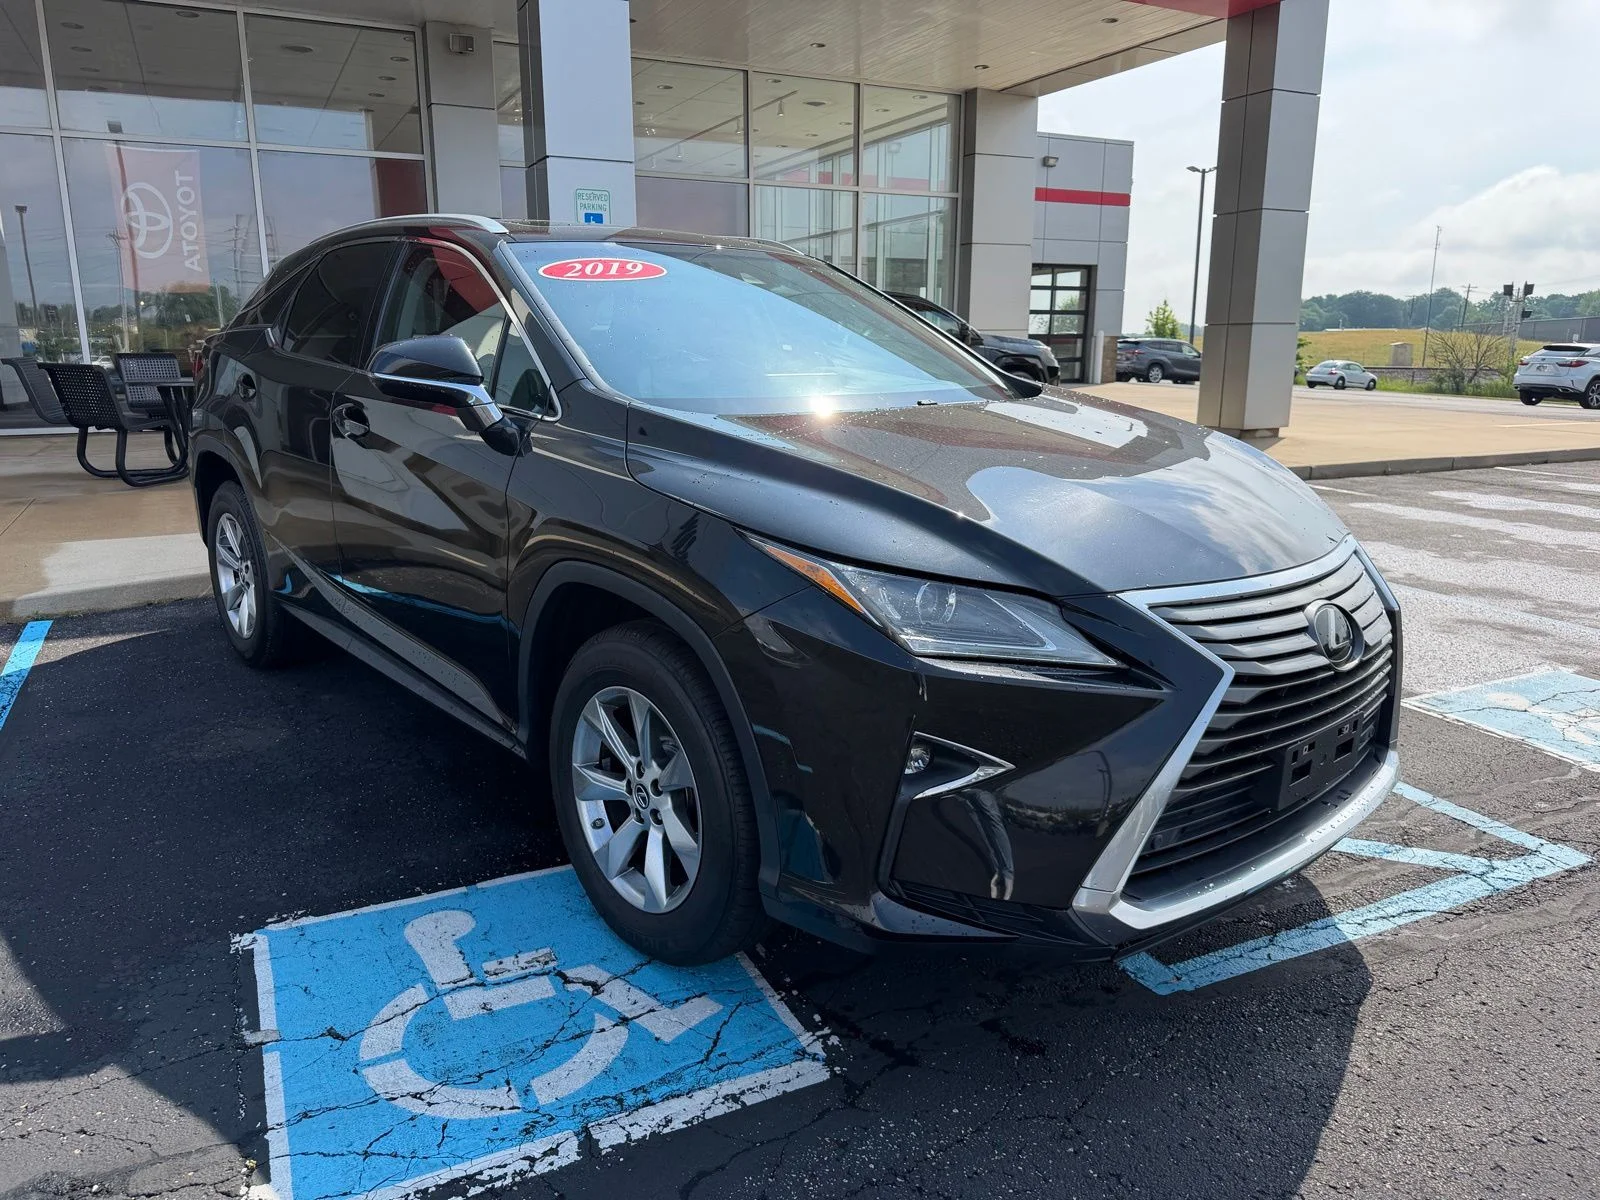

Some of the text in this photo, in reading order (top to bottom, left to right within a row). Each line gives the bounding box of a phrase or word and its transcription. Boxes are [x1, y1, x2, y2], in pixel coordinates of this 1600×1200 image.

[577, 192, 609, 201] RESERVED
[580, 202, 607, 211] PARKING
[564, 262, 643, 277] 2019
